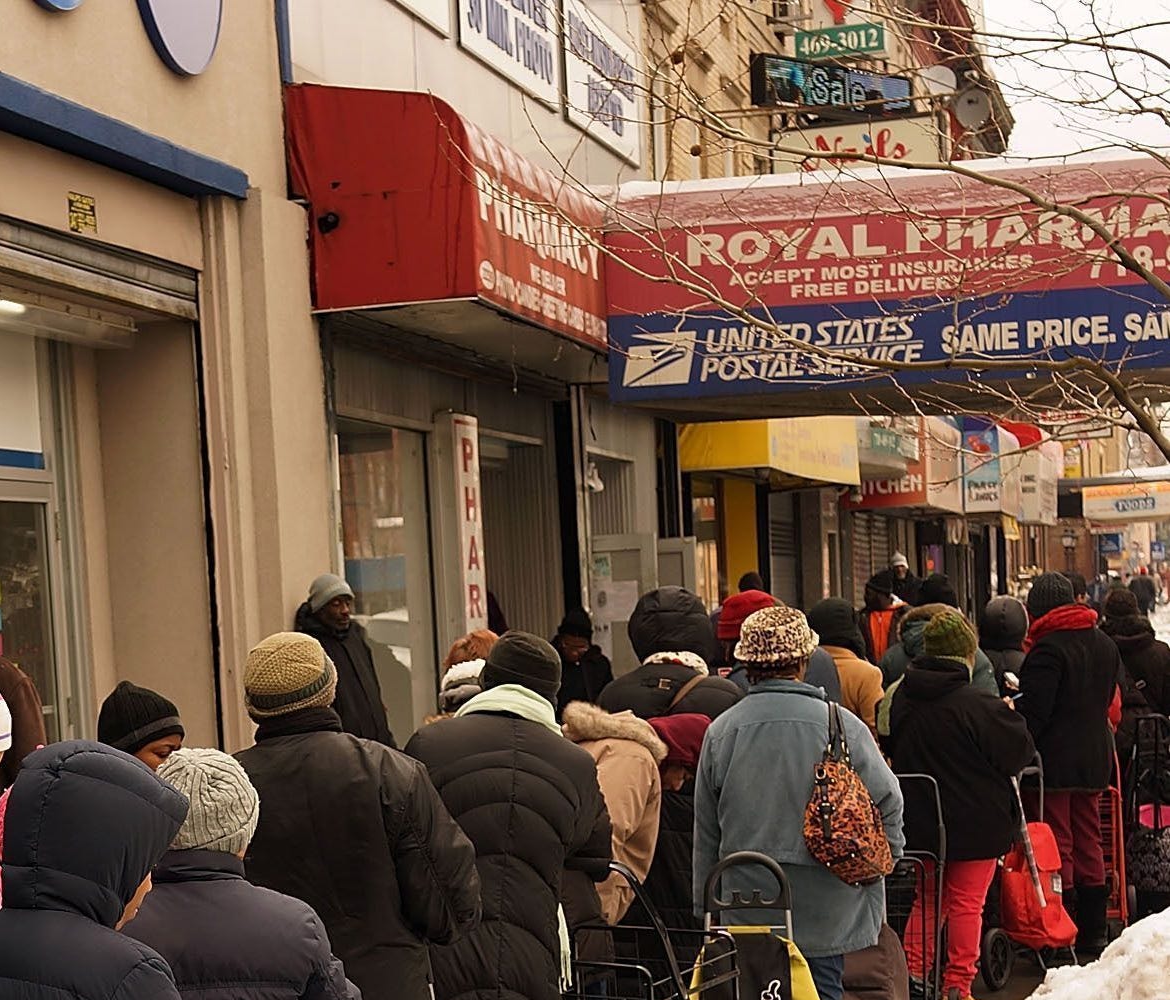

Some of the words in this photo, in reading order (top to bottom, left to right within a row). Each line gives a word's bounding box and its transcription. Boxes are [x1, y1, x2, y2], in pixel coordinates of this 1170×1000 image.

[515, 17, 553, 85] PHOTO
[811, 66, 867, 111] Sale
[475, 166, 599, 281] PHARMACY
[687, 224, 887, 267] ROYAL
[729, 268, 815, 286] ACCEPT
[821, 264, 883, 281] MOST
[889, 254, 1034, 277] INSURANCES
[791, 282, 848, 298] FREE
[854, 275, 965, 295] DELIVERY
[706, 322, 811, 353] UNITED
[814, 315, 915, 346] STATES
[941, 321, 1019, 354] SAME
[1026, 315, 1116, 349] PRICE.
[700, 351, 804, 382] POSTAL
[808, 344, 924, 376] SERVICE
[862, 474, 922, 496] ITCHEN
